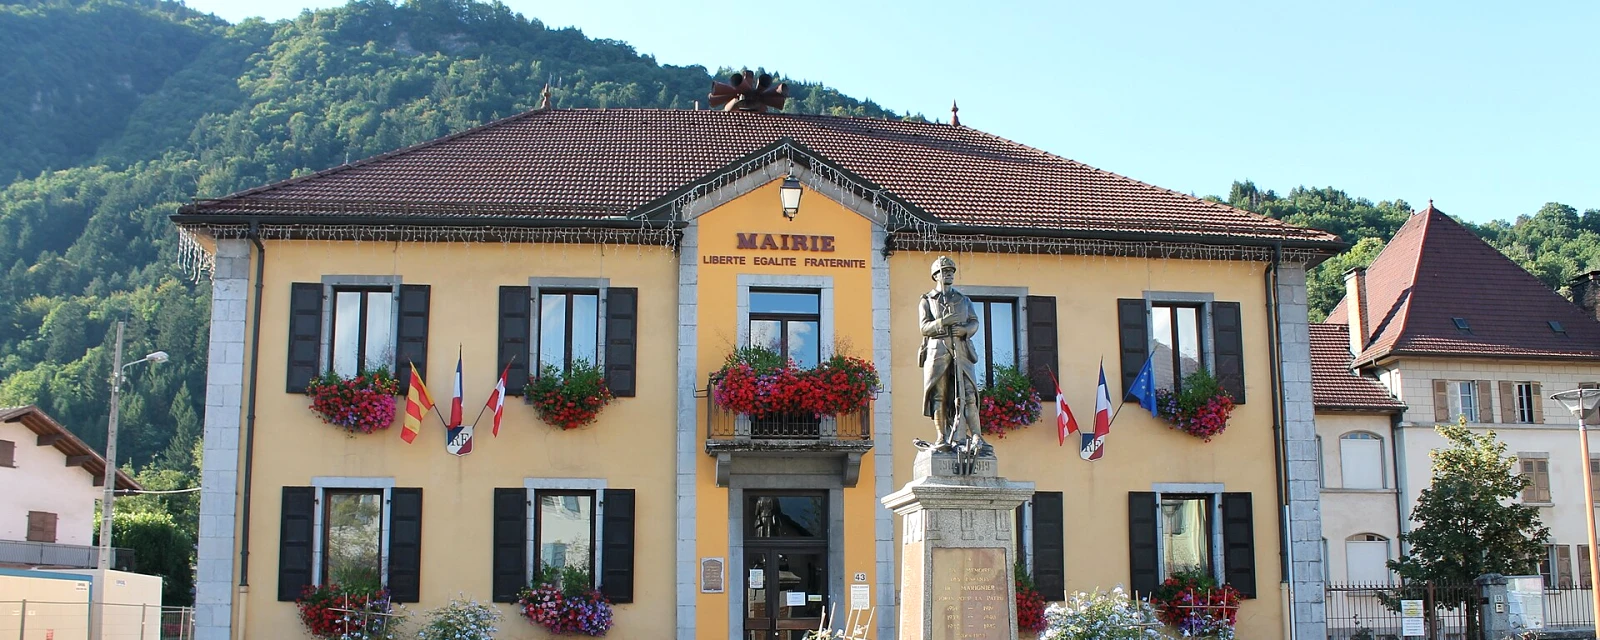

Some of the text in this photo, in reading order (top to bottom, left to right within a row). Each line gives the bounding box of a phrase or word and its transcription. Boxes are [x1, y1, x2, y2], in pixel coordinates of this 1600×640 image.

[737, 233, 835, 252] MAIRIE
[703, 255, 866, 269] LIBERTE EGALITE FRATERNITE
[450, 433, 469, 446] RF
[855, 573, 866, 581] 43
